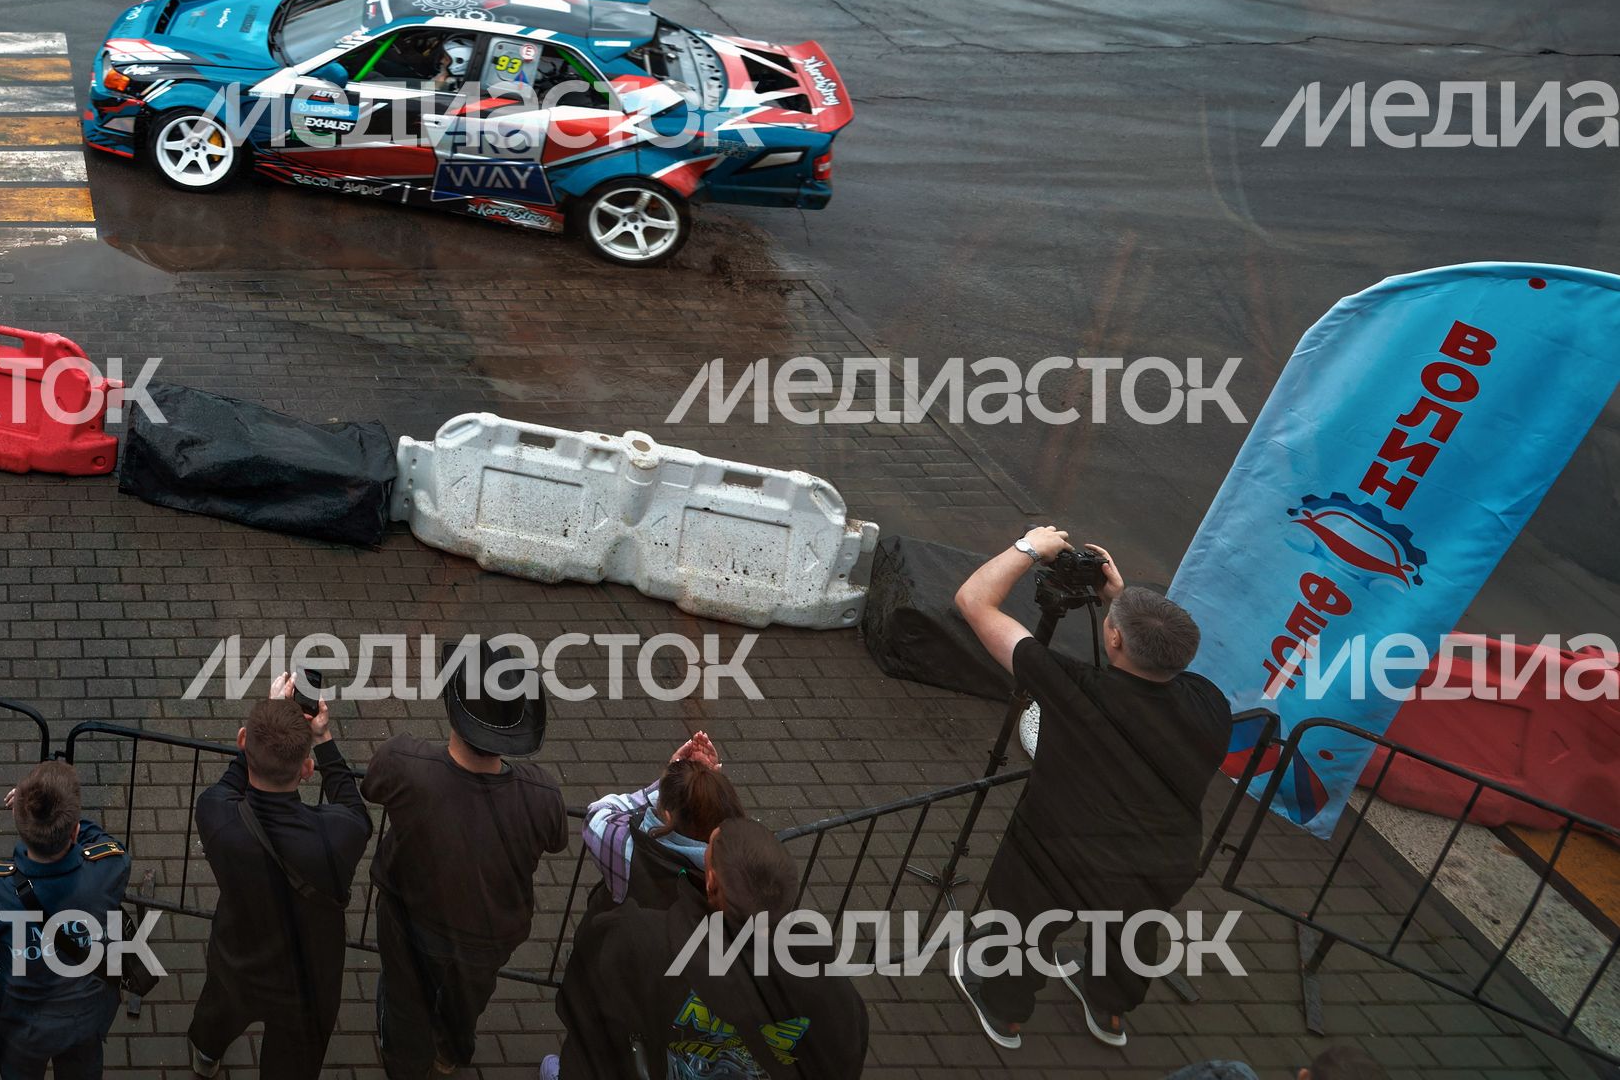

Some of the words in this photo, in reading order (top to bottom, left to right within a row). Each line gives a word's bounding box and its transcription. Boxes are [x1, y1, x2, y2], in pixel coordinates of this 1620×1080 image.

[495, 55, 523, 74] 93
[304, 117, 355, 131] EXHAUST
[445, 129, 533, 154] PRO
[292, 173, 340, 190] RECOIL
[445, 166, 534, 189] WAY
[1358, 320, 1498, 510] ВОЛИН
[1262, 572, 1352, 698] ФЕСТ
